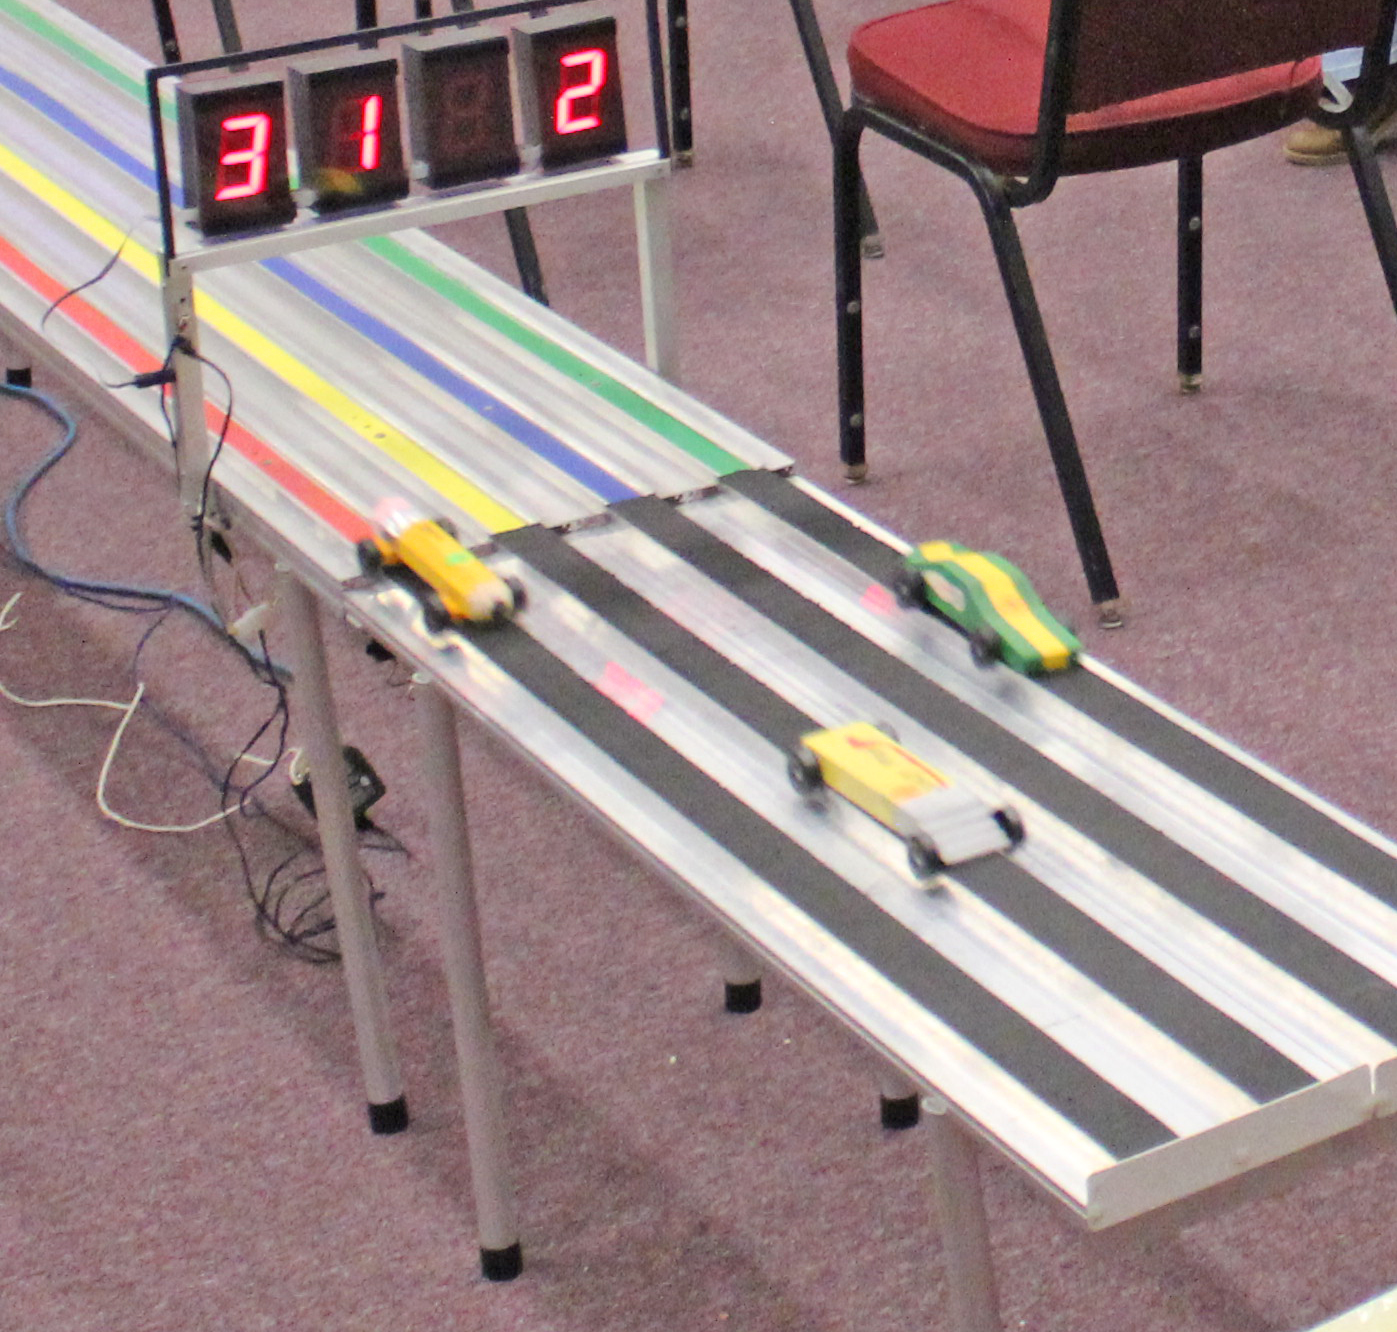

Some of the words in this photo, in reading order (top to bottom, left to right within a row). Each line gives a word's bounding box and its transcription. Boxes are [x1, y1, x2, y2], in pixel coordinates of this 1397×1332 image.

[214, 113, 271, 202] 3
[360, 93, 382, 172] 1
[554, 47, 608, 136] 2
